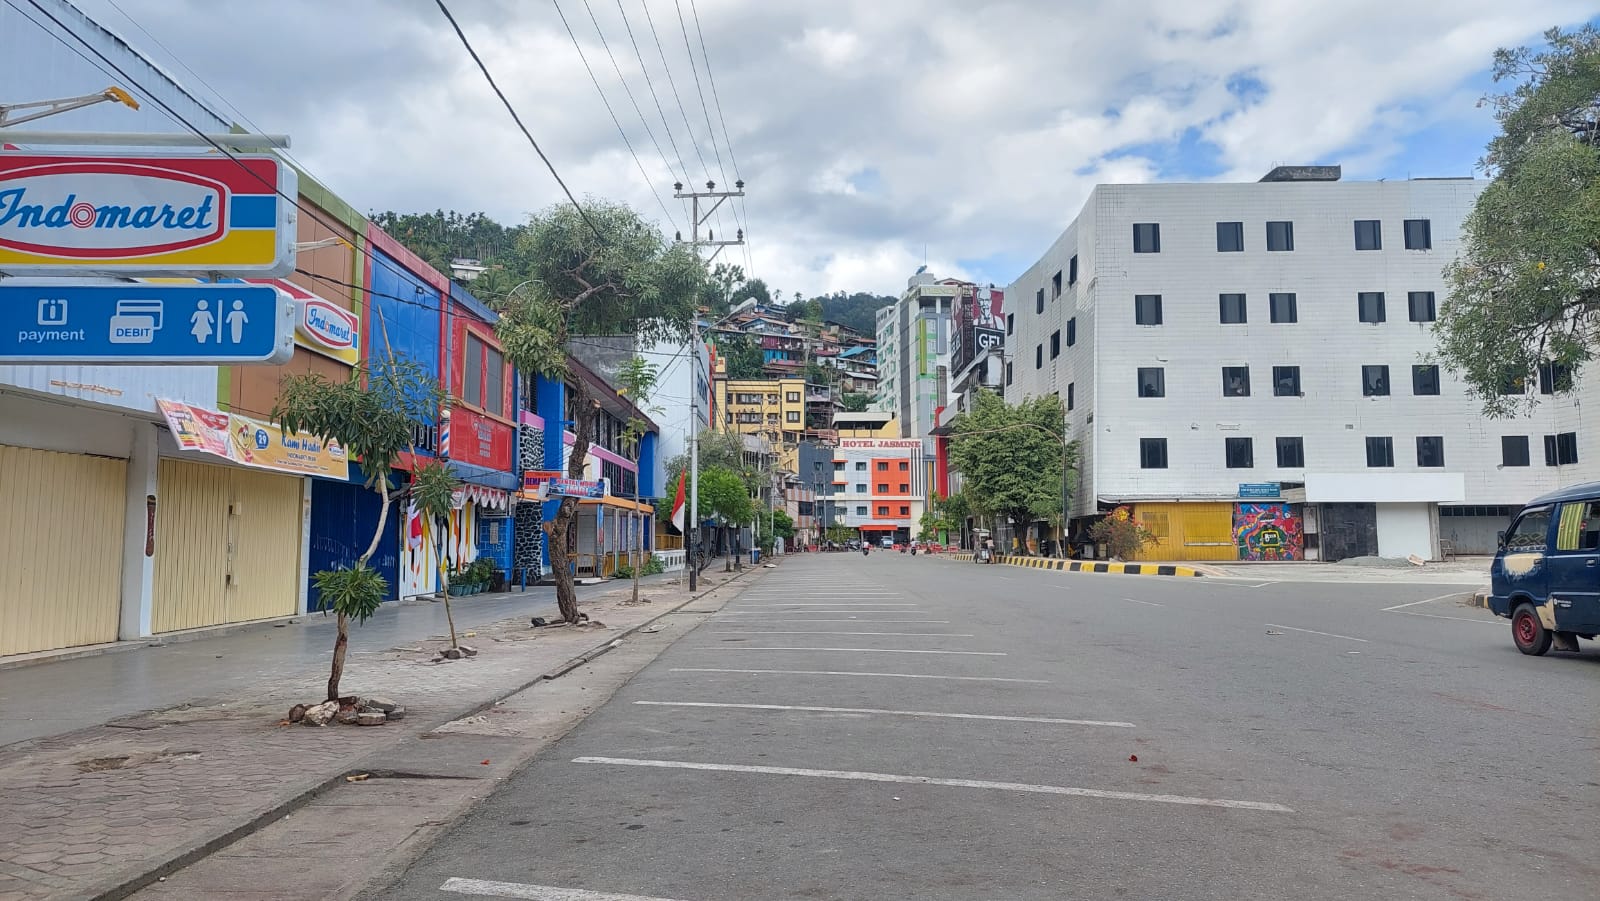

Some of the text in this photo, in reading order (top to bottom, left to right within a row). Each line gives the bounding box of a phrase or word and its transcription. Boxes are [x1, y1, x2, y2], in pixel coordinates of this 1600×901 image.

[0, 188, 213, 229] Indomaret
[308, 308, 350, 341] Indomaret
[18, 328, 85, 343] payment
[116, 328, 151, 337] DEBIT
[258, 434, 267, 445] 29
[282, 435, 299, 449] Kami
[842, 440, 921, 448] HOTEL JASMINE
